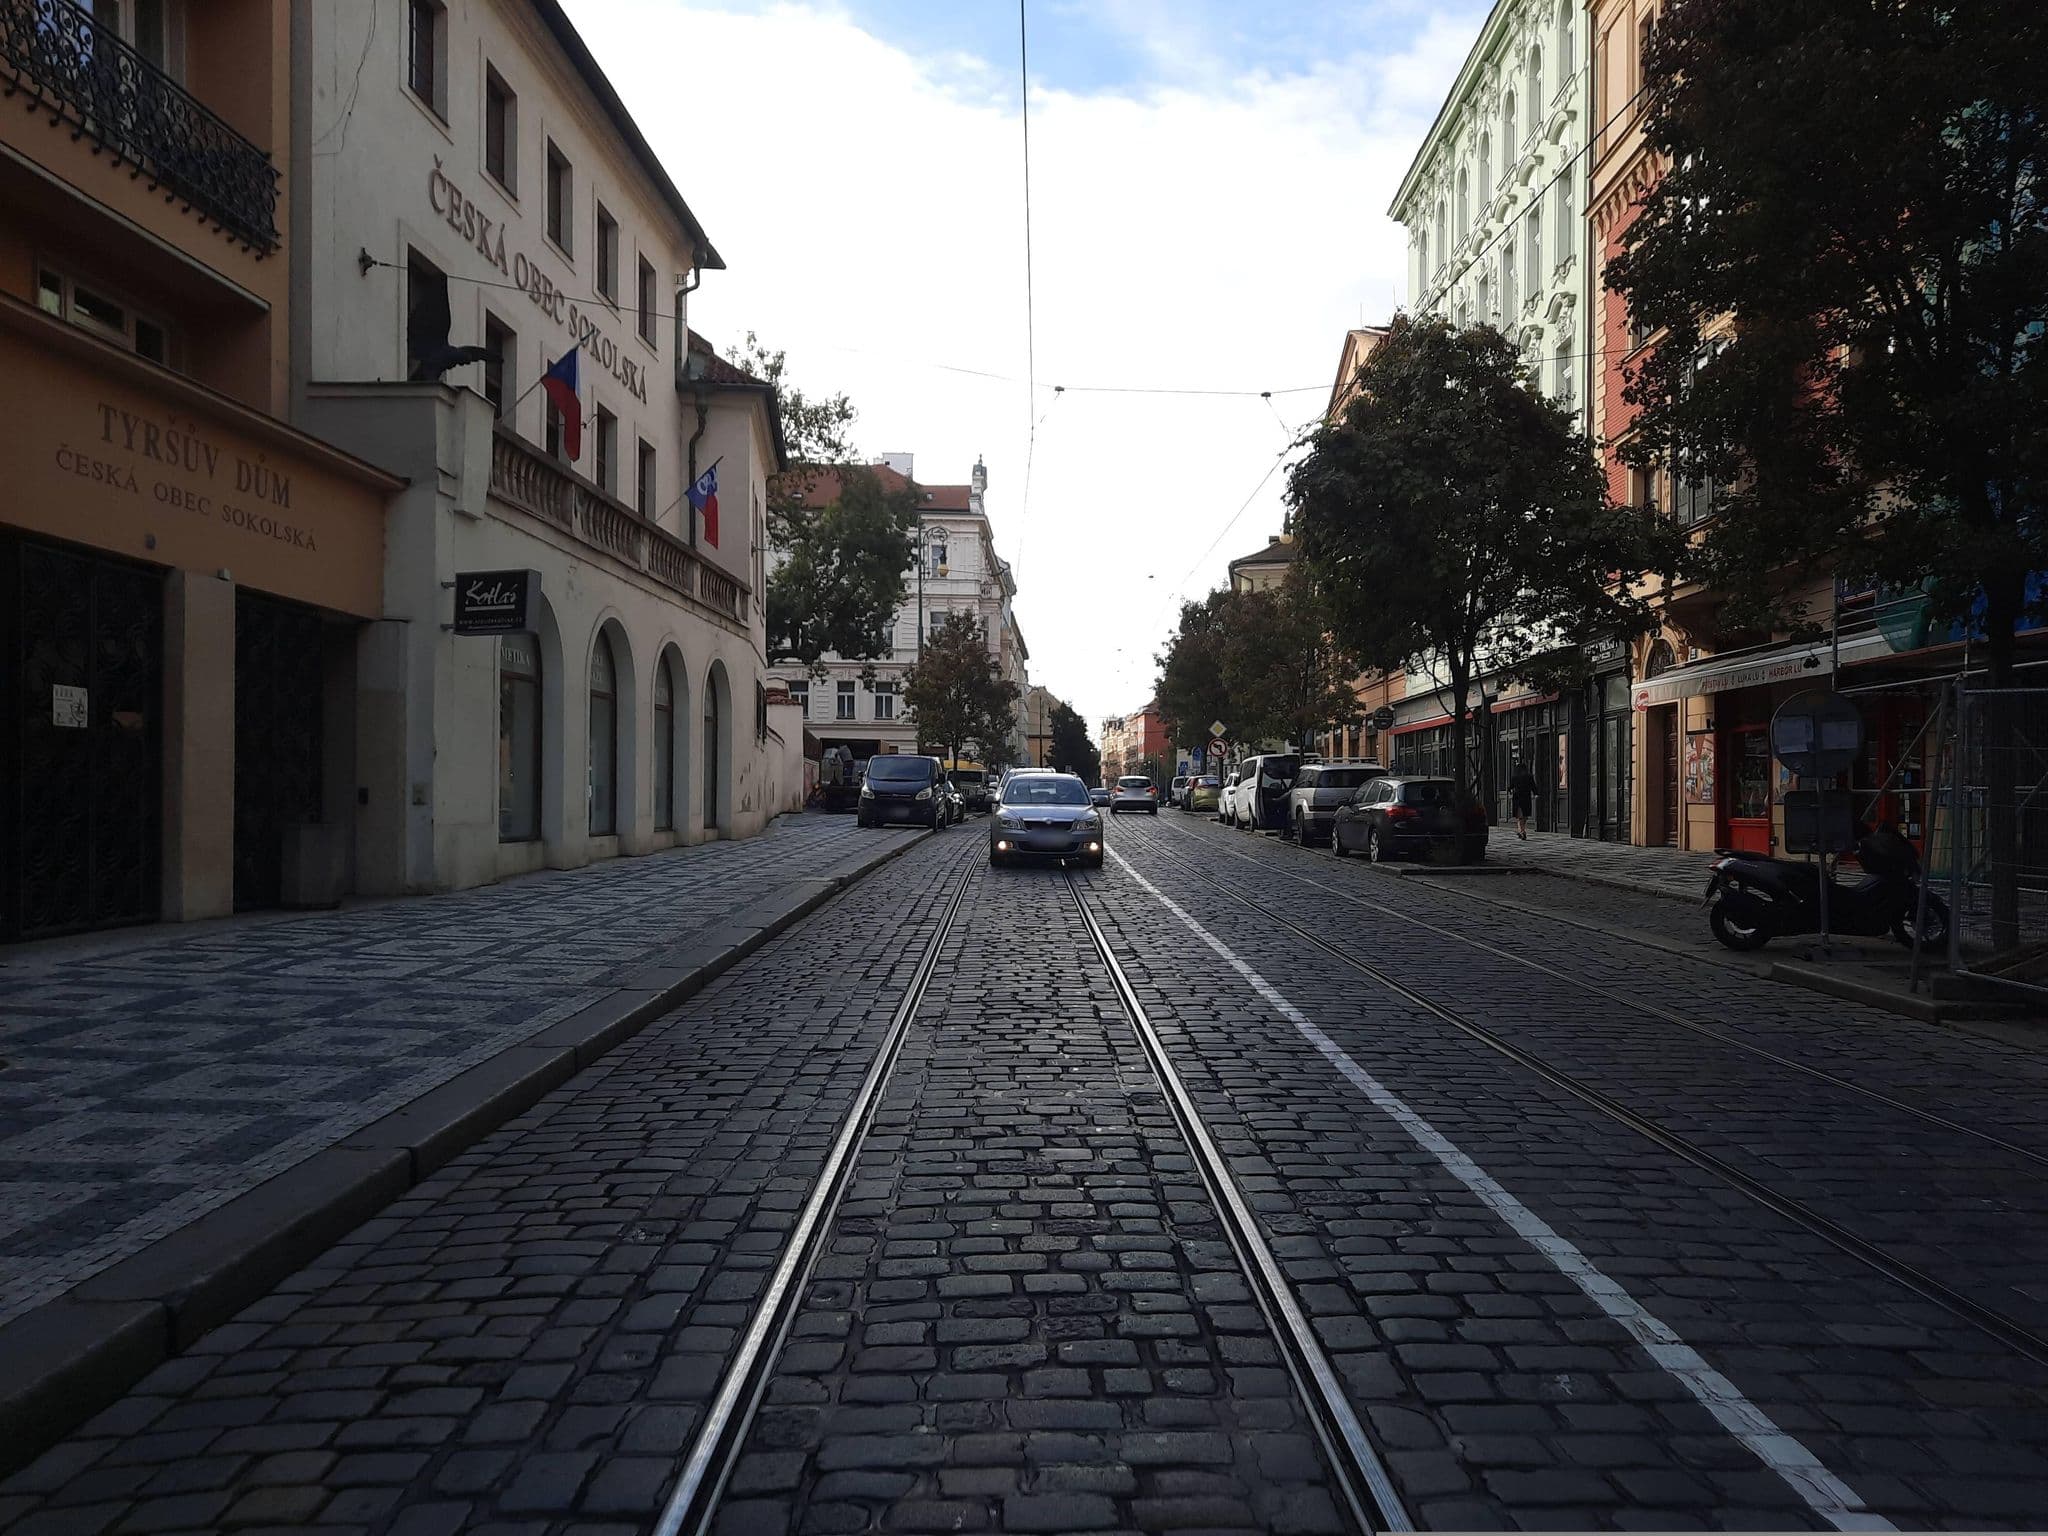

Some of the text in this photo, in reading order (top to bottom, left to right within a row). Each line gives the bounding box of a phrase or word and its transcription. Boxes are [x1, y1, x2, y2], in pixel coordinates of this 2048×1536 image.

[428, 154, 648, 405] ČESKÁ OBEC SOKOLSKÁ
[56, 443, 319, 552] ČESKÁ OBEC SOKOLSKÁ
[97, 402, 292, 508] TYRŠŮV DŮM
